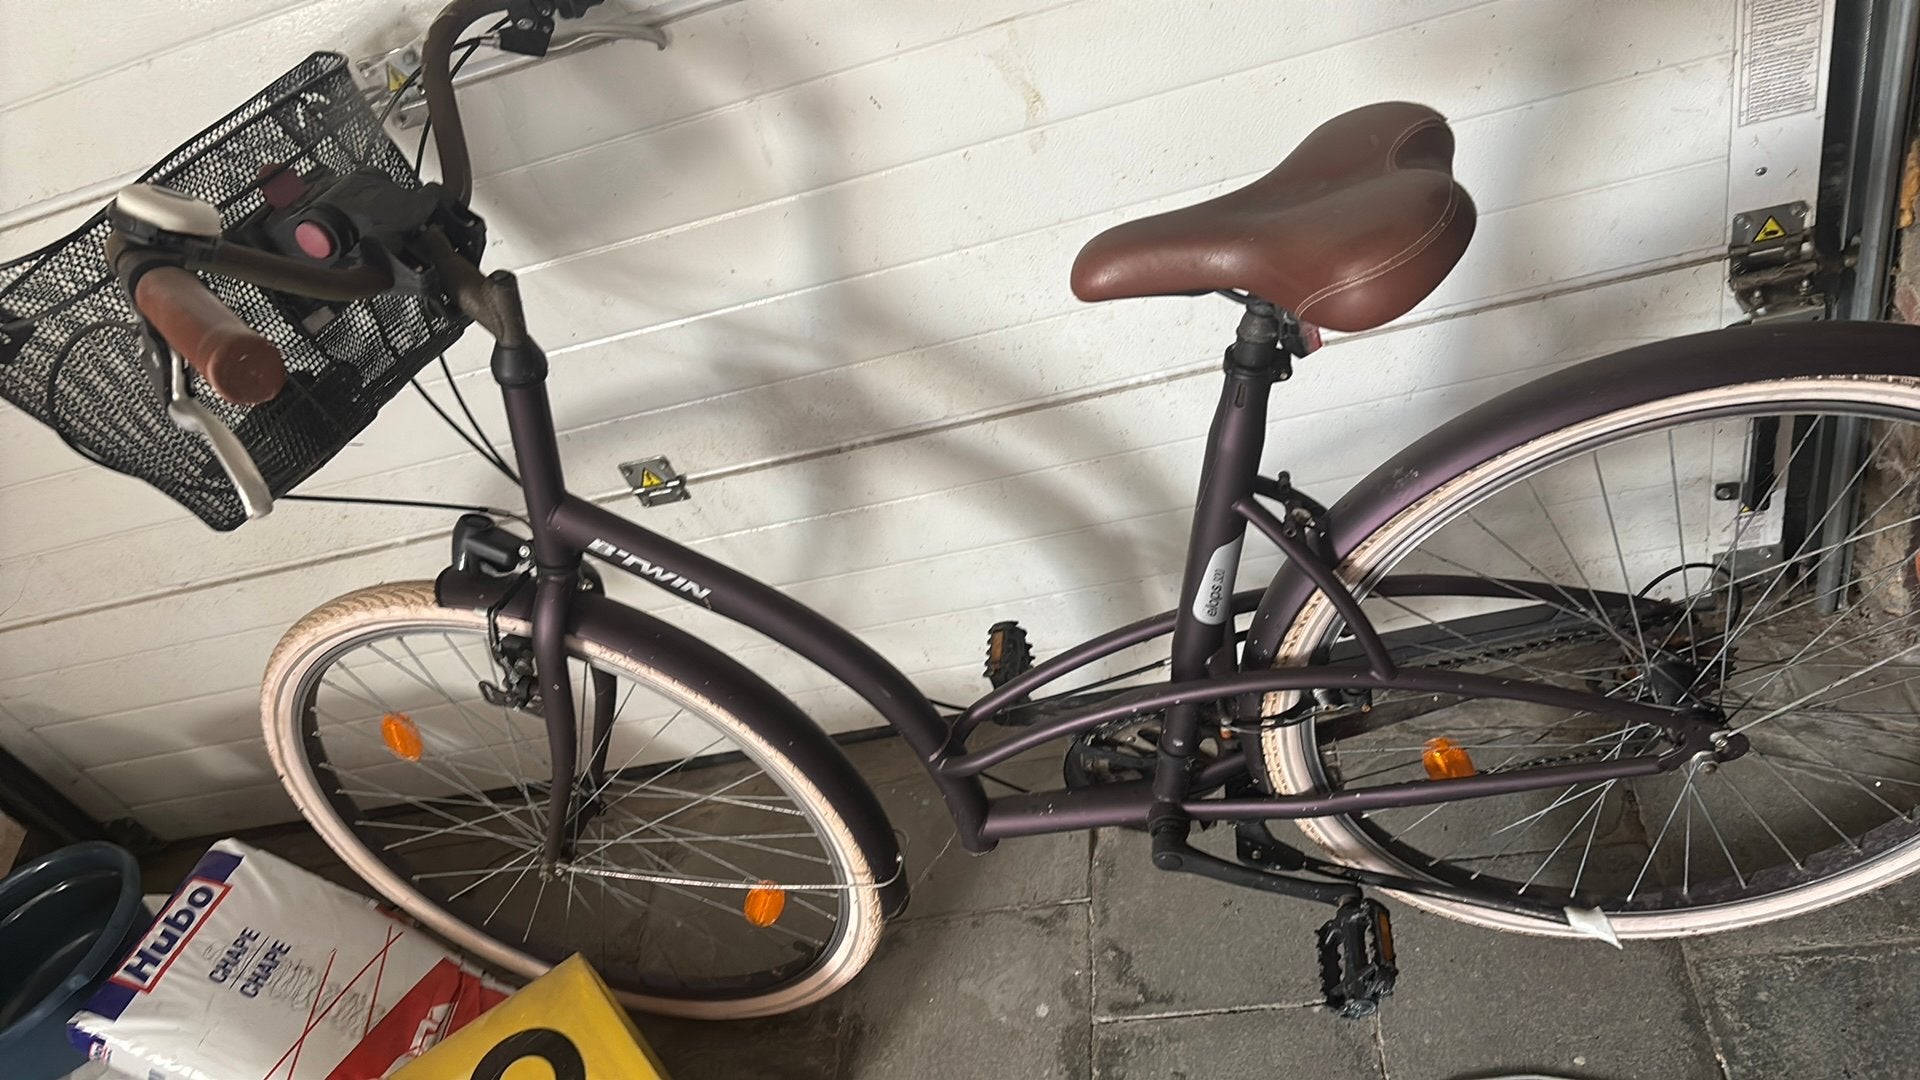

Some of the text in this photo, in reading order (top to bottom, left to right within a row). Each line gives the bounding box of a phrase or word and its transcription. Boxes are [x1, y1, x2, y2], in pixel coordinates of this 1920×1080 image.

[1205, 585, 1222, 617] elops
[123, 886, 214, 983] Hubo
[209, 927, 261, 983] CHAPE
[240, 940, 292, 998] CHAPE
